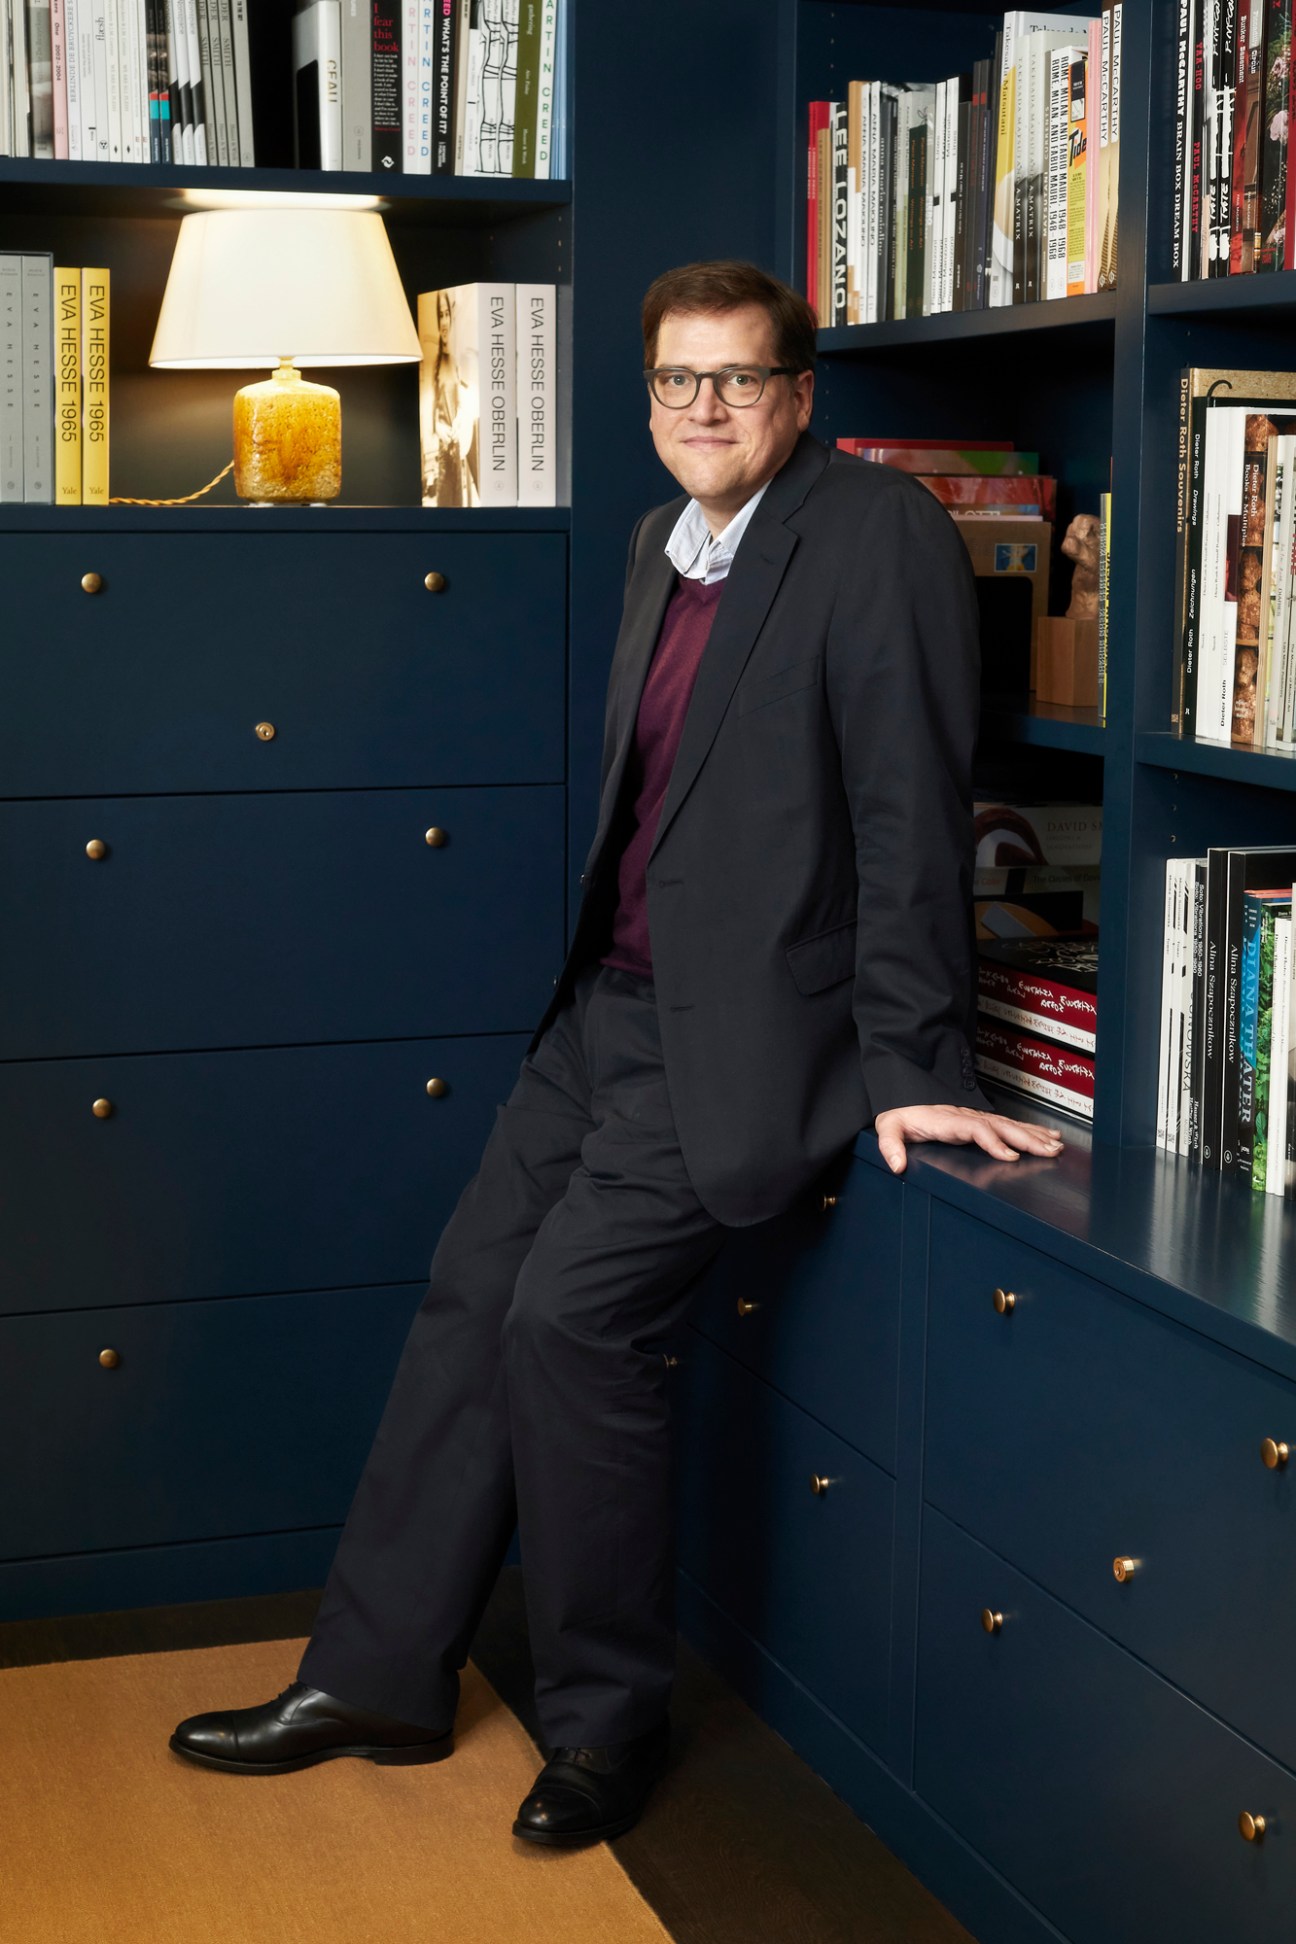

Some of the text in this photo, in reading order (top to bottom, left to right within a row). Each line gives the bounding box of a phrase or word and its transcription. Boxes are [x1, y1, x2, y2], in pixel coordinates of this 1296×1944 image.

[198, 1, 206, 21] DER
[209, 1, 218, 21] DER
[220, 1, 229, 22] DER
[374, 16, 393, 26] fear
[374, 29, 393, 39] this
[374, 42, 399, 52] book
[442, 18, 450, 53] WHAT'S
[441, 56, 449, 72] THE
[1000, 23, 1012, 136] Takesada Matsutani
[1101, 16, 1110, 140] PAUL McCARTHY
[1178, 40, 1187, 116] McCARTHY
[1195, 42, 1203, 90] YAA-HOO
[1250, 50, 1258, 74] Circus
[440, 76, 448, 106] POINT
[440, 106, 448, 118] OF
[1112, 54, 1120, 136] McCARTHY
[408, 81, 416, 156] CREED
[421, 82, 430, 156] CREED
[439, 121, 447, 134] IT?
[540, 87, 550, 161] CREED
[1050, 124, 1059, 143] AND
[1060, 122, 1068, 140] AND
[1050, 146, 1059, 172] FABIO
[1059, 143, 1067, 170] FABIO
[1069, 128, 1087, 167] Tide
[1176, 121, 1184, 161] BRAIN
[1174, 165, 1182, 191] BOX
[835, 111, 848, 309] LEE LOZANO
[1192, 174, 1200, 233] McCARTHY
[6, 343, 14, 408] HESSE
[61, 285, 78, 442] EVA HESSE 1965
[89, 285, 105, 442] EVA HESSE 1965
[490, 296, 506, 472] EVA HESSE OBERLIN
[530, 298, 544, 472] EVA HESSE OBERLIN
[1176, 378, 1189, 533] Dieter Roth Souvenirs
[62, 486, 78, 496] Yale
[89, 486, 105, 496] Yale
[1250, 464, 1260, 517] Dieter Roth
[1188, 568, 1196, 619] Zeichnungen
[1047, 822, 1087, 832] DAVID
[1246, 941, 1257, 1017] DIANA
[1206, 974, 1216, 1059] Szapocznikow
[1228, 944, 1238, 1064] Alina Szapocznikow
[1242, 1024, 1254, 1124] THATER
